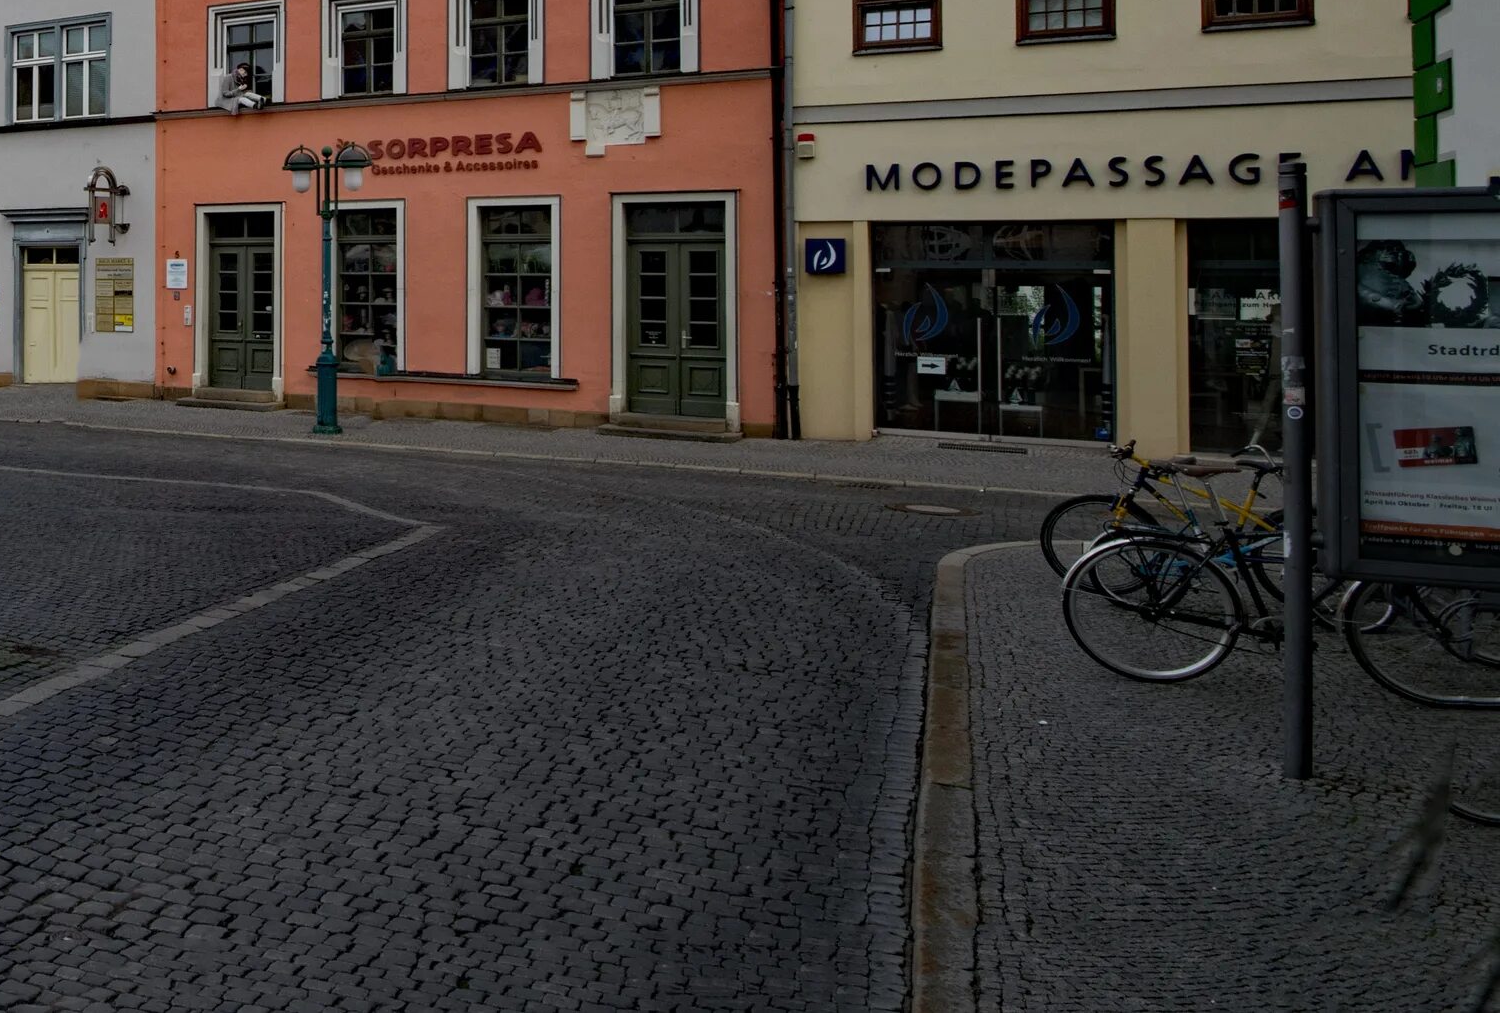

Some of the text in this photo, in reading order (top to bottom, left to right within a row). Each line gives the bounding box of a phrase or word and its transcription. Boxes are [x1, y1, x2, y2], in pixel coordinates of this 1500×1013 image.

[366, 131, 543, 160] SORPRESA
[371, 158, 539, 176] Geschenke & Accessoires
[1364, 499, 1383, 507] April
[1397, 500, 1430, 508] Oktober
